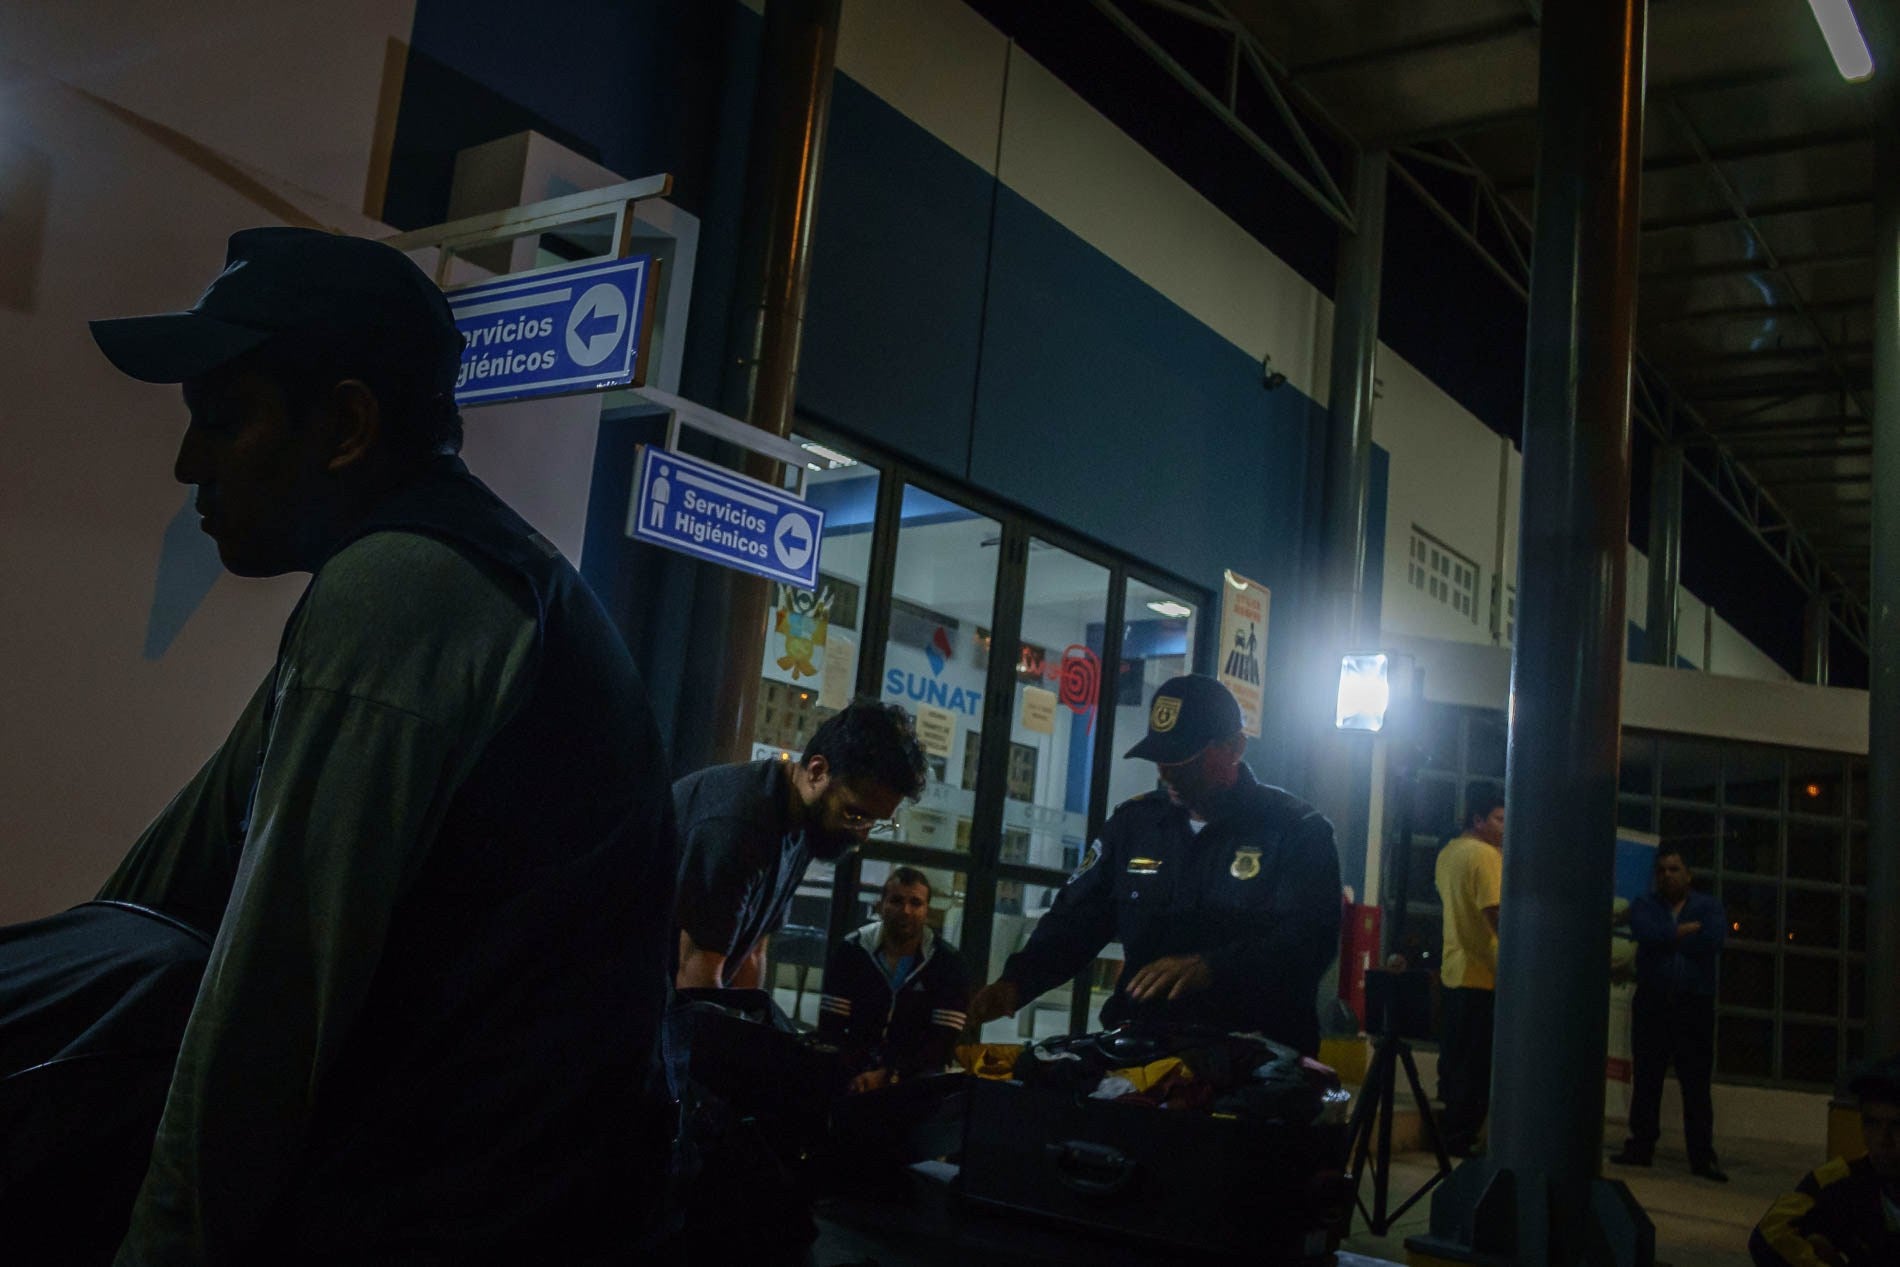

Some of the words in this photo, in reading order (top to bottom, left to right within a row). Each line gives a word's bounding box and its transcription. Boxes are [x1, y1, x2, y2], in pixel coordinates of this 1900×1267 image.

[461, 315, 554, 351] ervicios
[457, 350, 556, 388] giénicos
[684, 490, 767, 534] Servicios
[675, 511, 769, 559] Higiénicos
[887, 668, 982, 715] SUNAT
